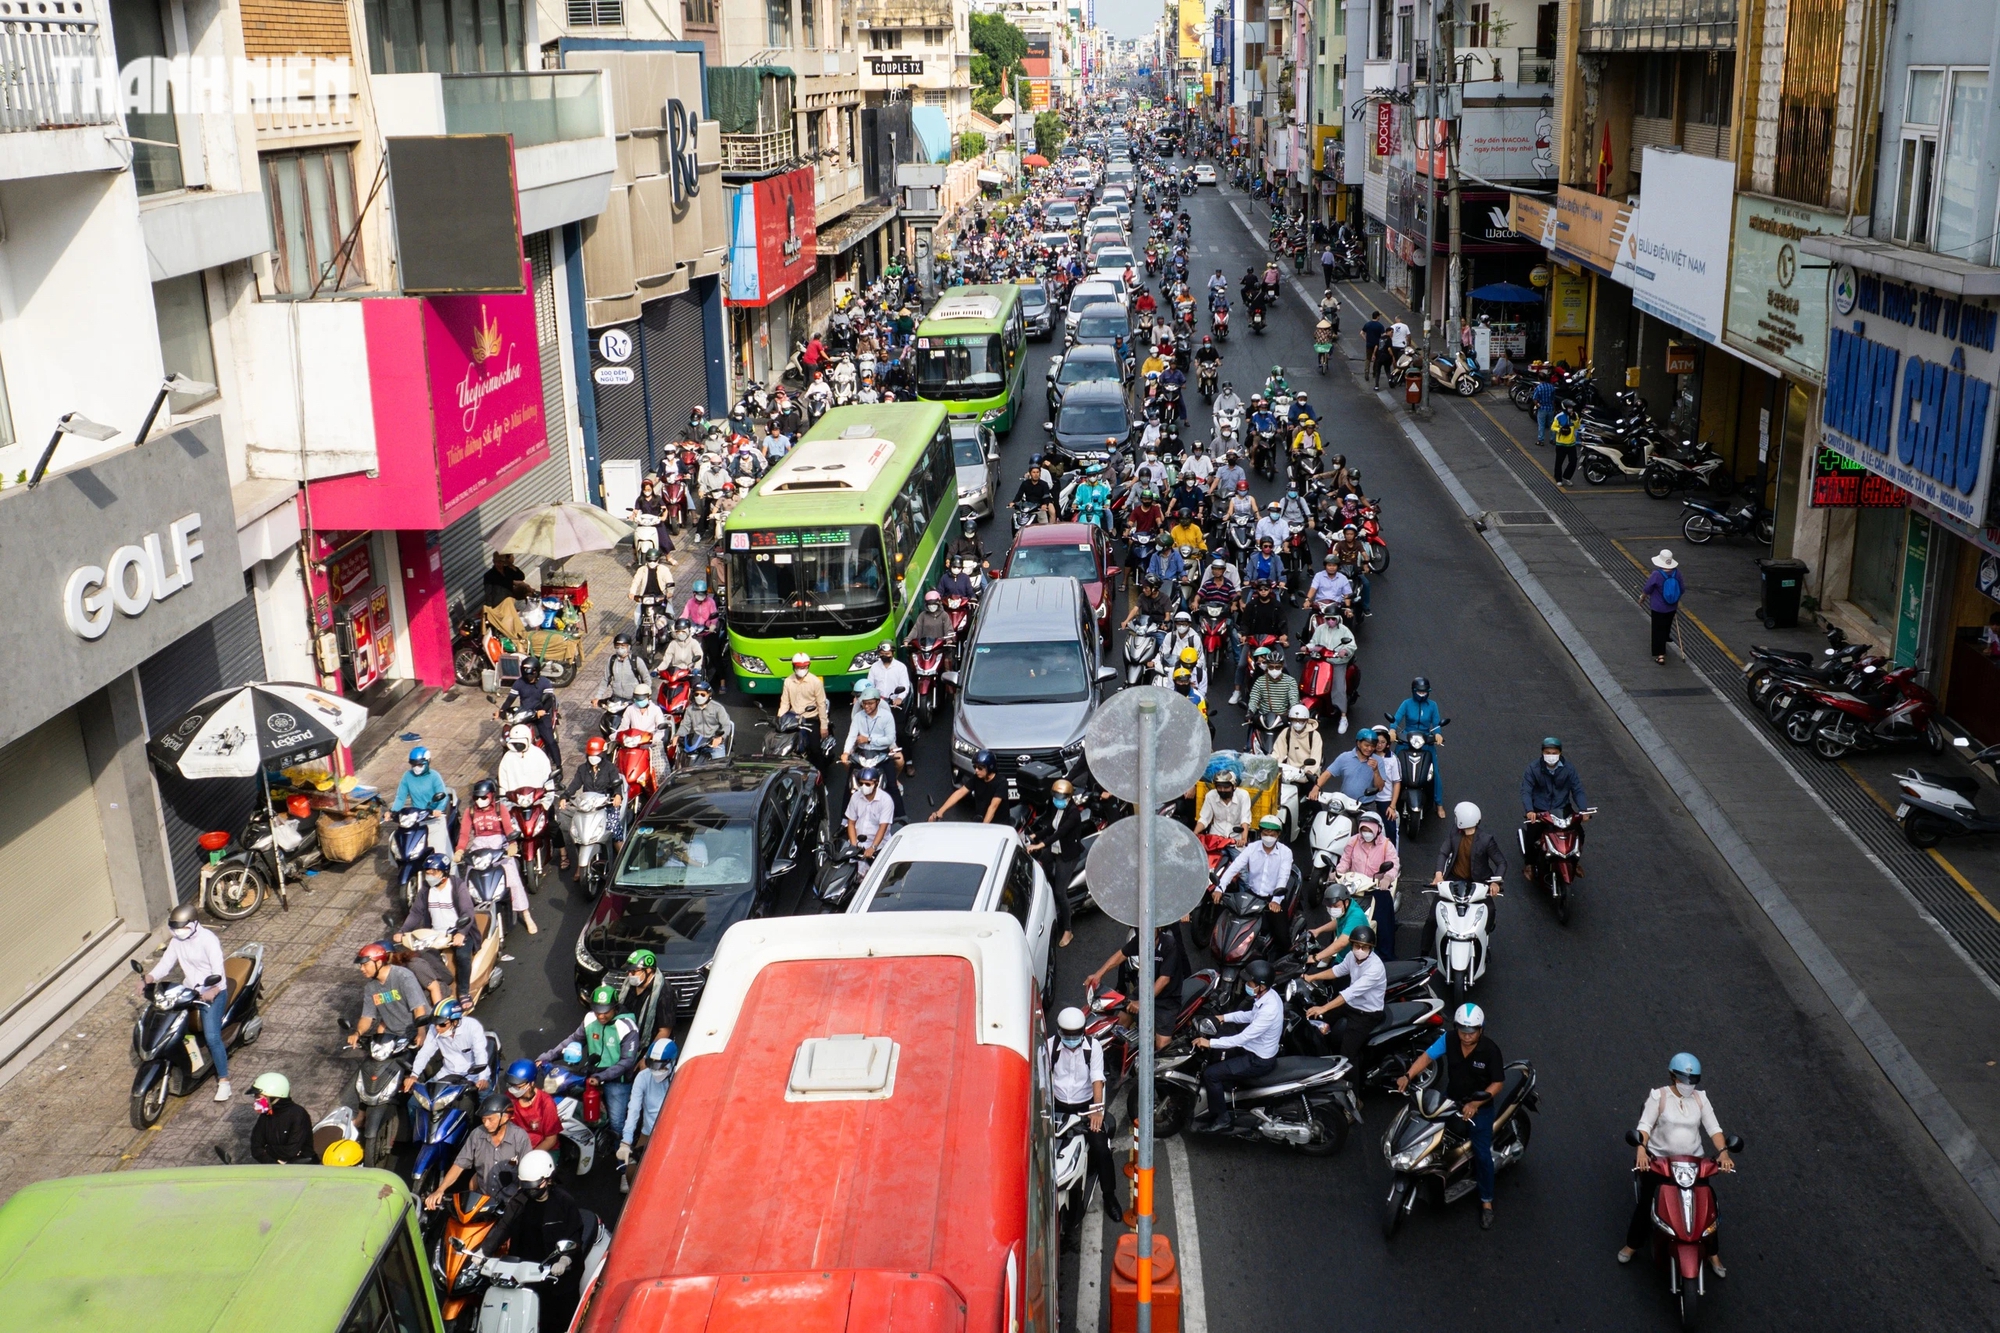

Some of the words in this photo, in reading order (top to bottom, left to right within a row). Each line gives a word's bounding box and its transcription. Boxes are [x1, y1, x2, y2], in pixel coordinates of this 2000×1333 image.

[875, 63, 908, 74] COUPLE
[910, 62, 921, 73] TX
[1378, 106, 1389, 153] JOCKEY
[1485, 228, 1522, 239] Wacoa
[1638, 238, 1653, 255] BƯU
[1653, 243, 1670, 264] ĐIỆN
[1671, 249, 1687, 271] VIỆT
[1688, 258, 1706, 275] NAM
[919, 338, 928, 347] 31
[1670, 360, 1695, 370] ATM
[1897, 346, 1992, 496] CHÂU
[1827, 432, 1844, 451] CHUYÊN
[1874, 456, 1885, 473] CÁC
[1885, 462, 1896, 481] LOẠI
[1897, 467, 1915, 491] THUỐC
[1915, 476, 1925, 495] TÂY
[1926, 482, 1935, 500] NỘI
[1939, 494, 1957, 514] NGOẠI
[1957, 500, 1974, 519] NHẬP
[733, 534, 746, 548] 36
[752, 531, 776, 546] 36
[63, 511, 205, 639] GOLF
[160, 733, 184, 752] Legend
[270, 729, 314, 749] Legend
